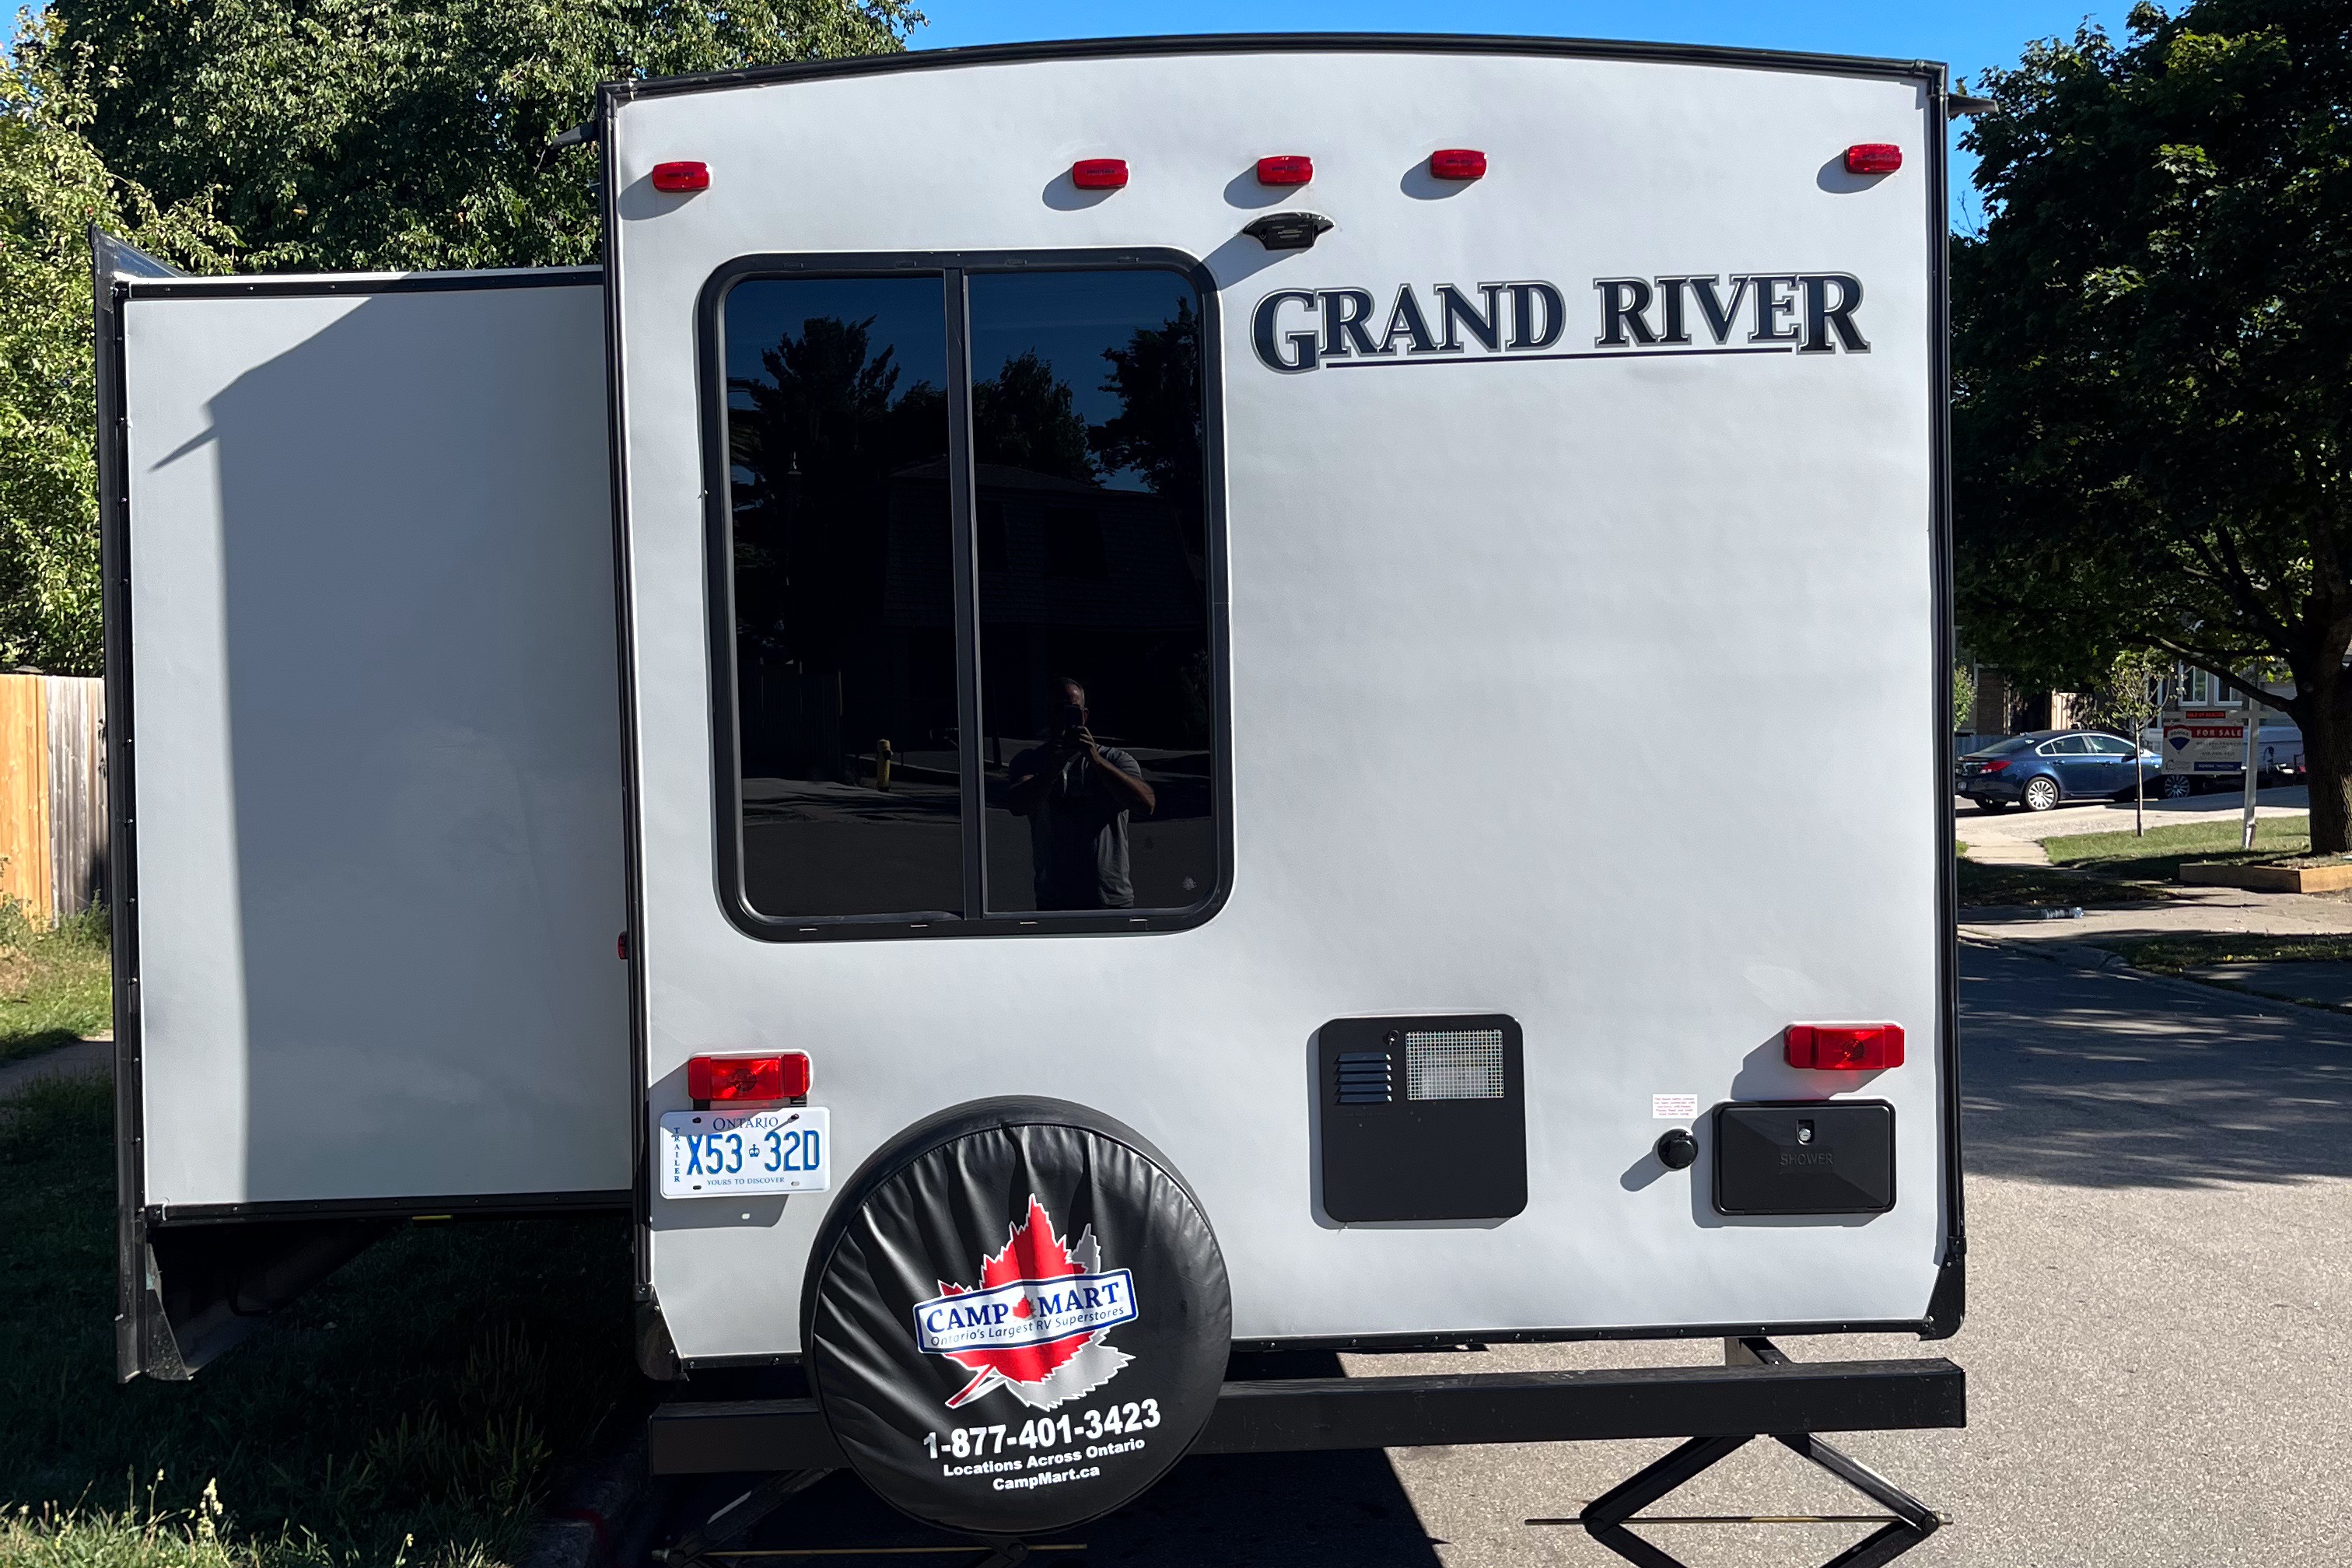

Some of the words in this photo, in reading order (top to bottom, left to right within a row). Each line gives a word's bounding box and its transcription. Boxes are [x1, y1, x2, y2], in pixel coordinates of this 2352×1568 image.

[1250, 280, 1566, 375] GRAND
[1593, 271, 1871, 354] RIVER
[712, 1117, 779, 1131] ONTARIO
[686, 1133, 743, 1175] X53
[764, 1129, 821, 1172] 32D
[1780, 1153, 1834, 1166] SHOWER
[747, 1176, 785, 1185] DISCOVER
[926, 1303, 1009, 1333] CAMP
[1037, 1282, 1119, 1318] MART
[931, 1328, 985, 1346] Ontario's
[989, 1321, 1033, 1338] Largest
[1036, 1319, 1052, 1330] RV
[1055, 1307, 1124, 1328] Superstores
[923, 1398, 1161, 1459] 1-877-401-3423
[943, 1460, 1023, 1476] Locations
[1027, 1451, 1083, 1468] Across
[1086, 1438, 1146, 1458] Ontario
[993, 1466, 1101, 1490] CampMart.ca
